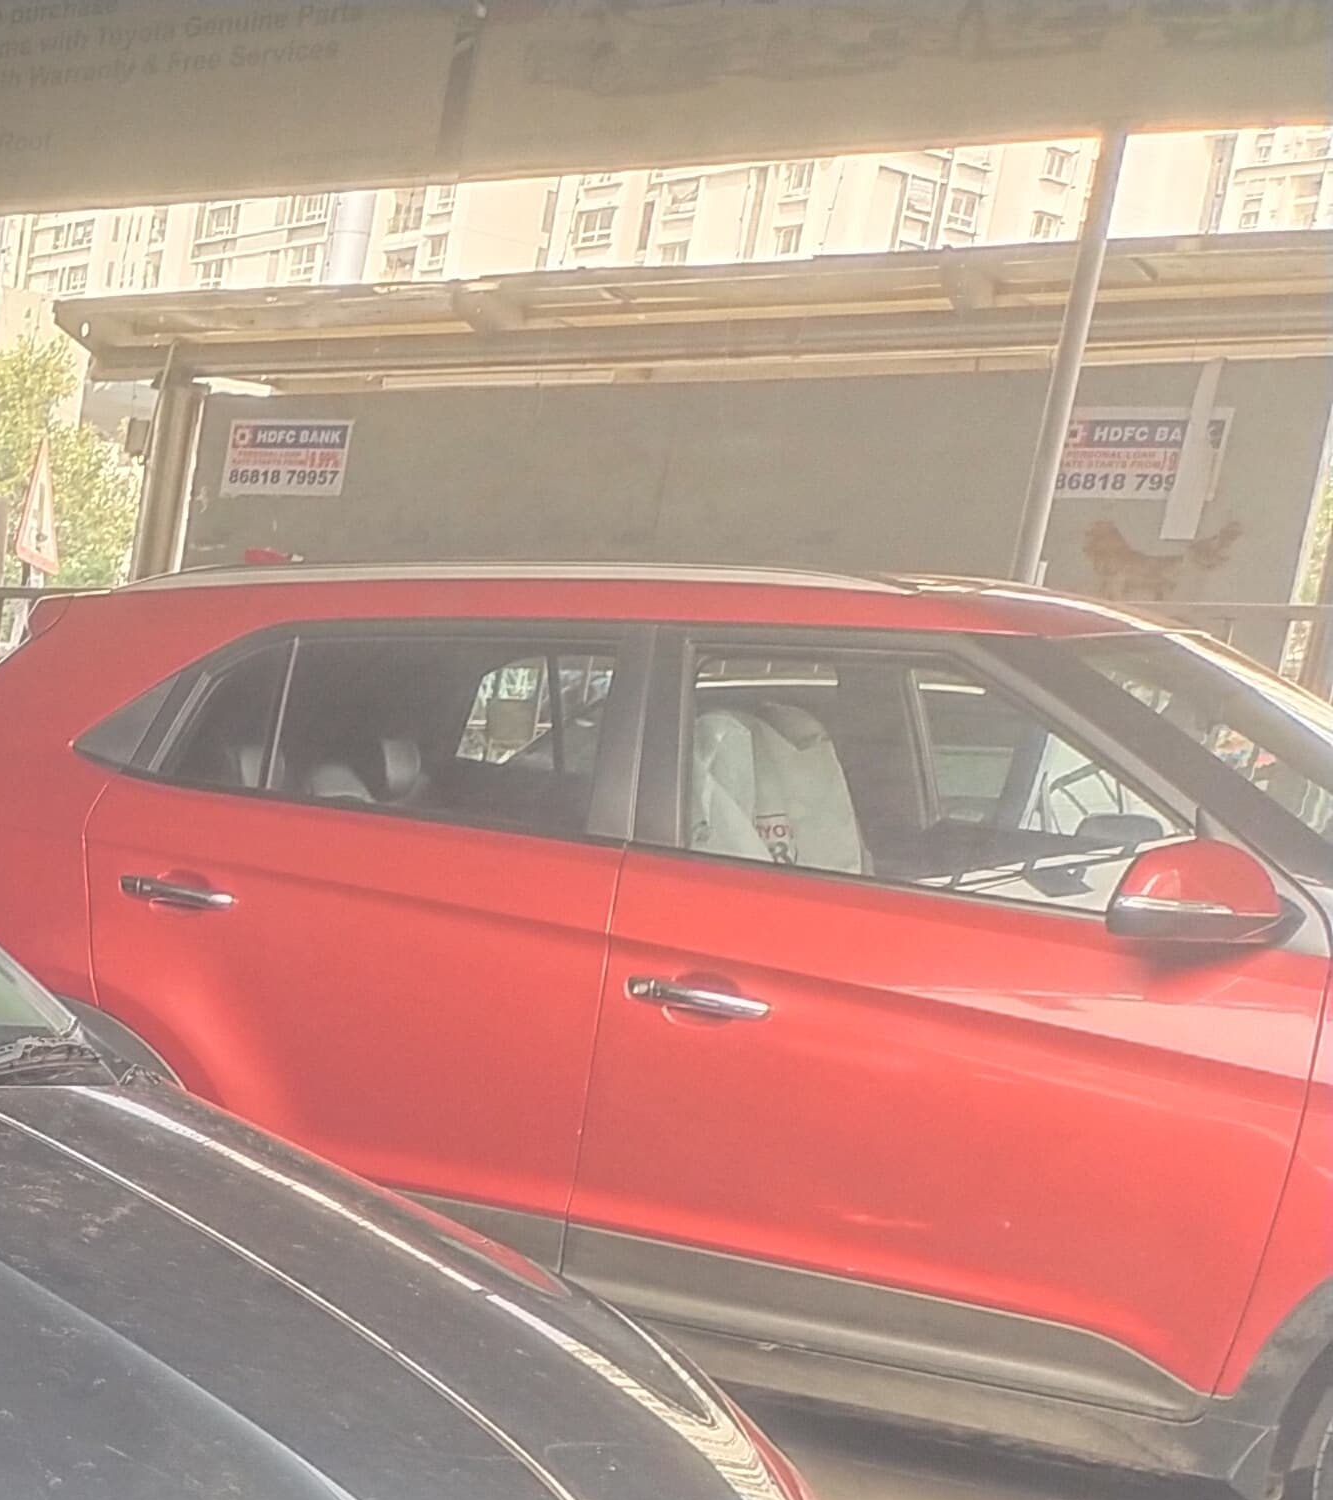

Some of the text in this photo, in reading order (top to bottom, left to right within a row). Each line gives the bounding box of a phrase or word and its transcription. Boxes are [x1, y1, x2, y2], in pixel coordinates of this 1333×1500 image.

[40, 29, 88, 53] with
[184, 10, 287, 38] Genuine
[298, 2, 364, 27] Parts
[168, 50, 221, 73] Free
[231, 40, 341, 68] Services
[256, 430, 342, 444] HDFC BANK
[1093, 426, 1150, 442] HDFC
[228, 469, 340, 485] 86818 79957
